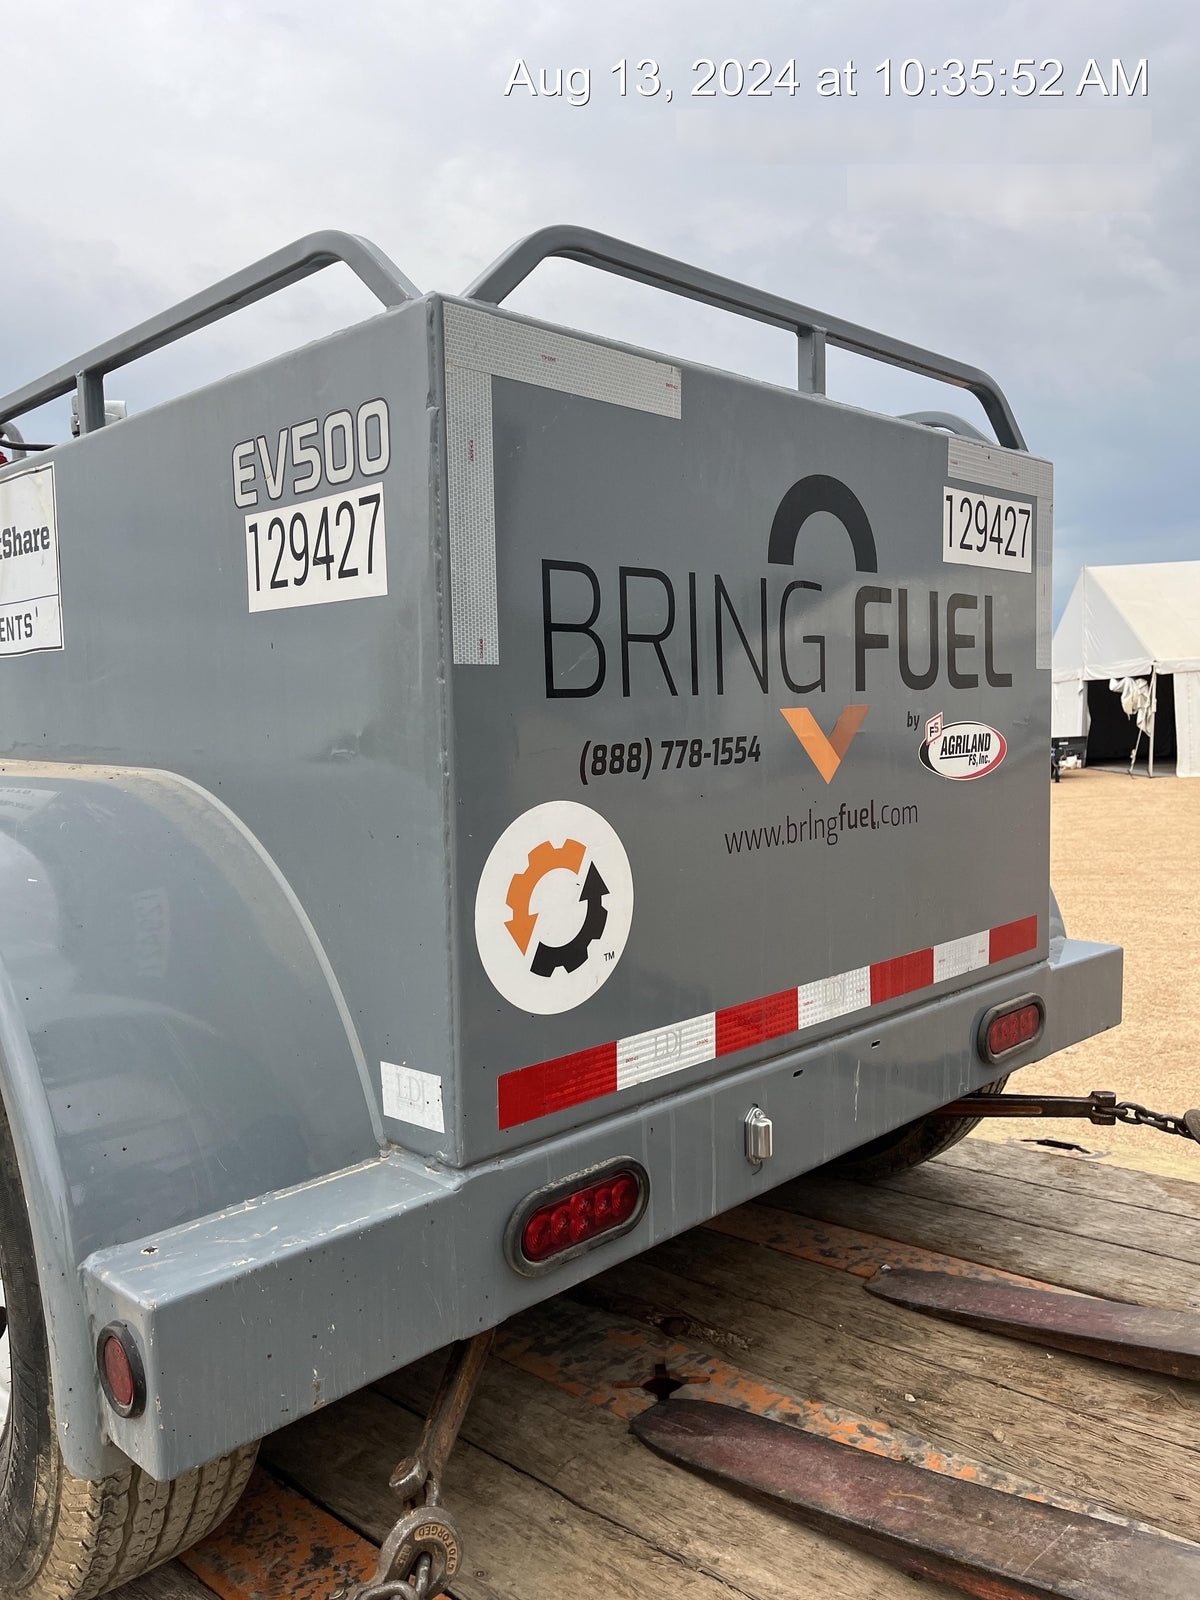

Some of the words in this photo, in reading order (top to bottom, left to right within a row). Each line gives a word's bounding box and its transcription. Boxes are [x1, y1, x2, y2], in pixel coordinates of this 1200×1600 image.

[231, 397, 391, 509] EV500
[248, 492, 382, 592] 129427
[945, 494, 1031, 559] 129427
[541, 558, 826, 699] BRING
[854, 585, 1013, 692] FUEL
[906, 711, 920, 732] by
[929, 722, 940, 738] FS
[579, 737, 653, 786] (888)
[661, 735, 761, 770] 778-1554
[940, 733, 992, 756] AGRILAND
[968, 754, 978, 768] FS,
[979, 752, 991, 765] Inc.
[724, 799, 919, 855] www.bringfuel.com
[603, 950, 616, 962] TM
[418, 1525, 454, 1549] FORGED
